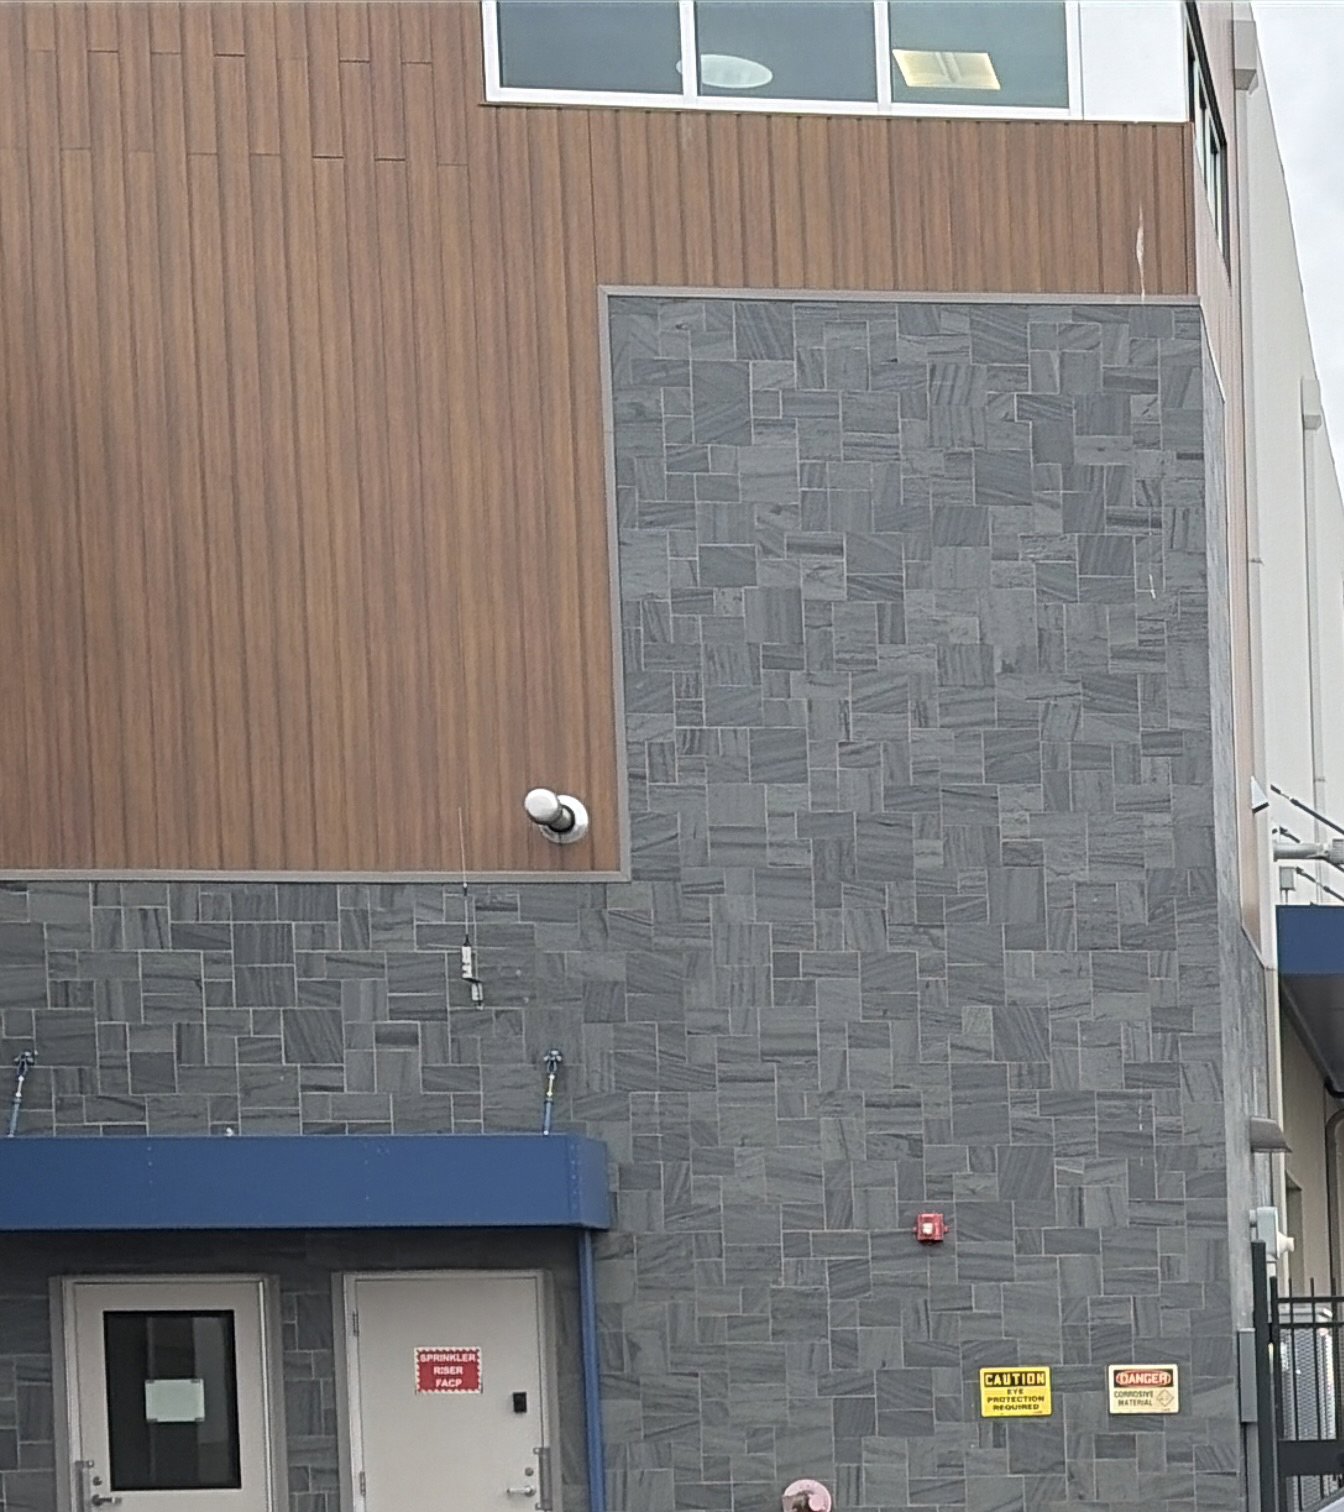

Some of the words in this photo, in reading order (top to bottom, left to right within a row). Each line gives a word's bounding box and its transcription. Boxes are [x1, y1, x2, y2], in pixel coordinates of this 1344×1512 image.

[420, 1353, 476, 1362] SPRINKLER
[433, 1366, 463, 1375] RISER
[435, 1378, 462, 1387] FACP
[984, 1372, 1045, 1386] CAUTION
[1120, 1372, 1169, 1385] DANGER
[1114, 1390, 1154, 1398] CORROSIVE
[986, 1395, 1045, 1403] PROTECTION
